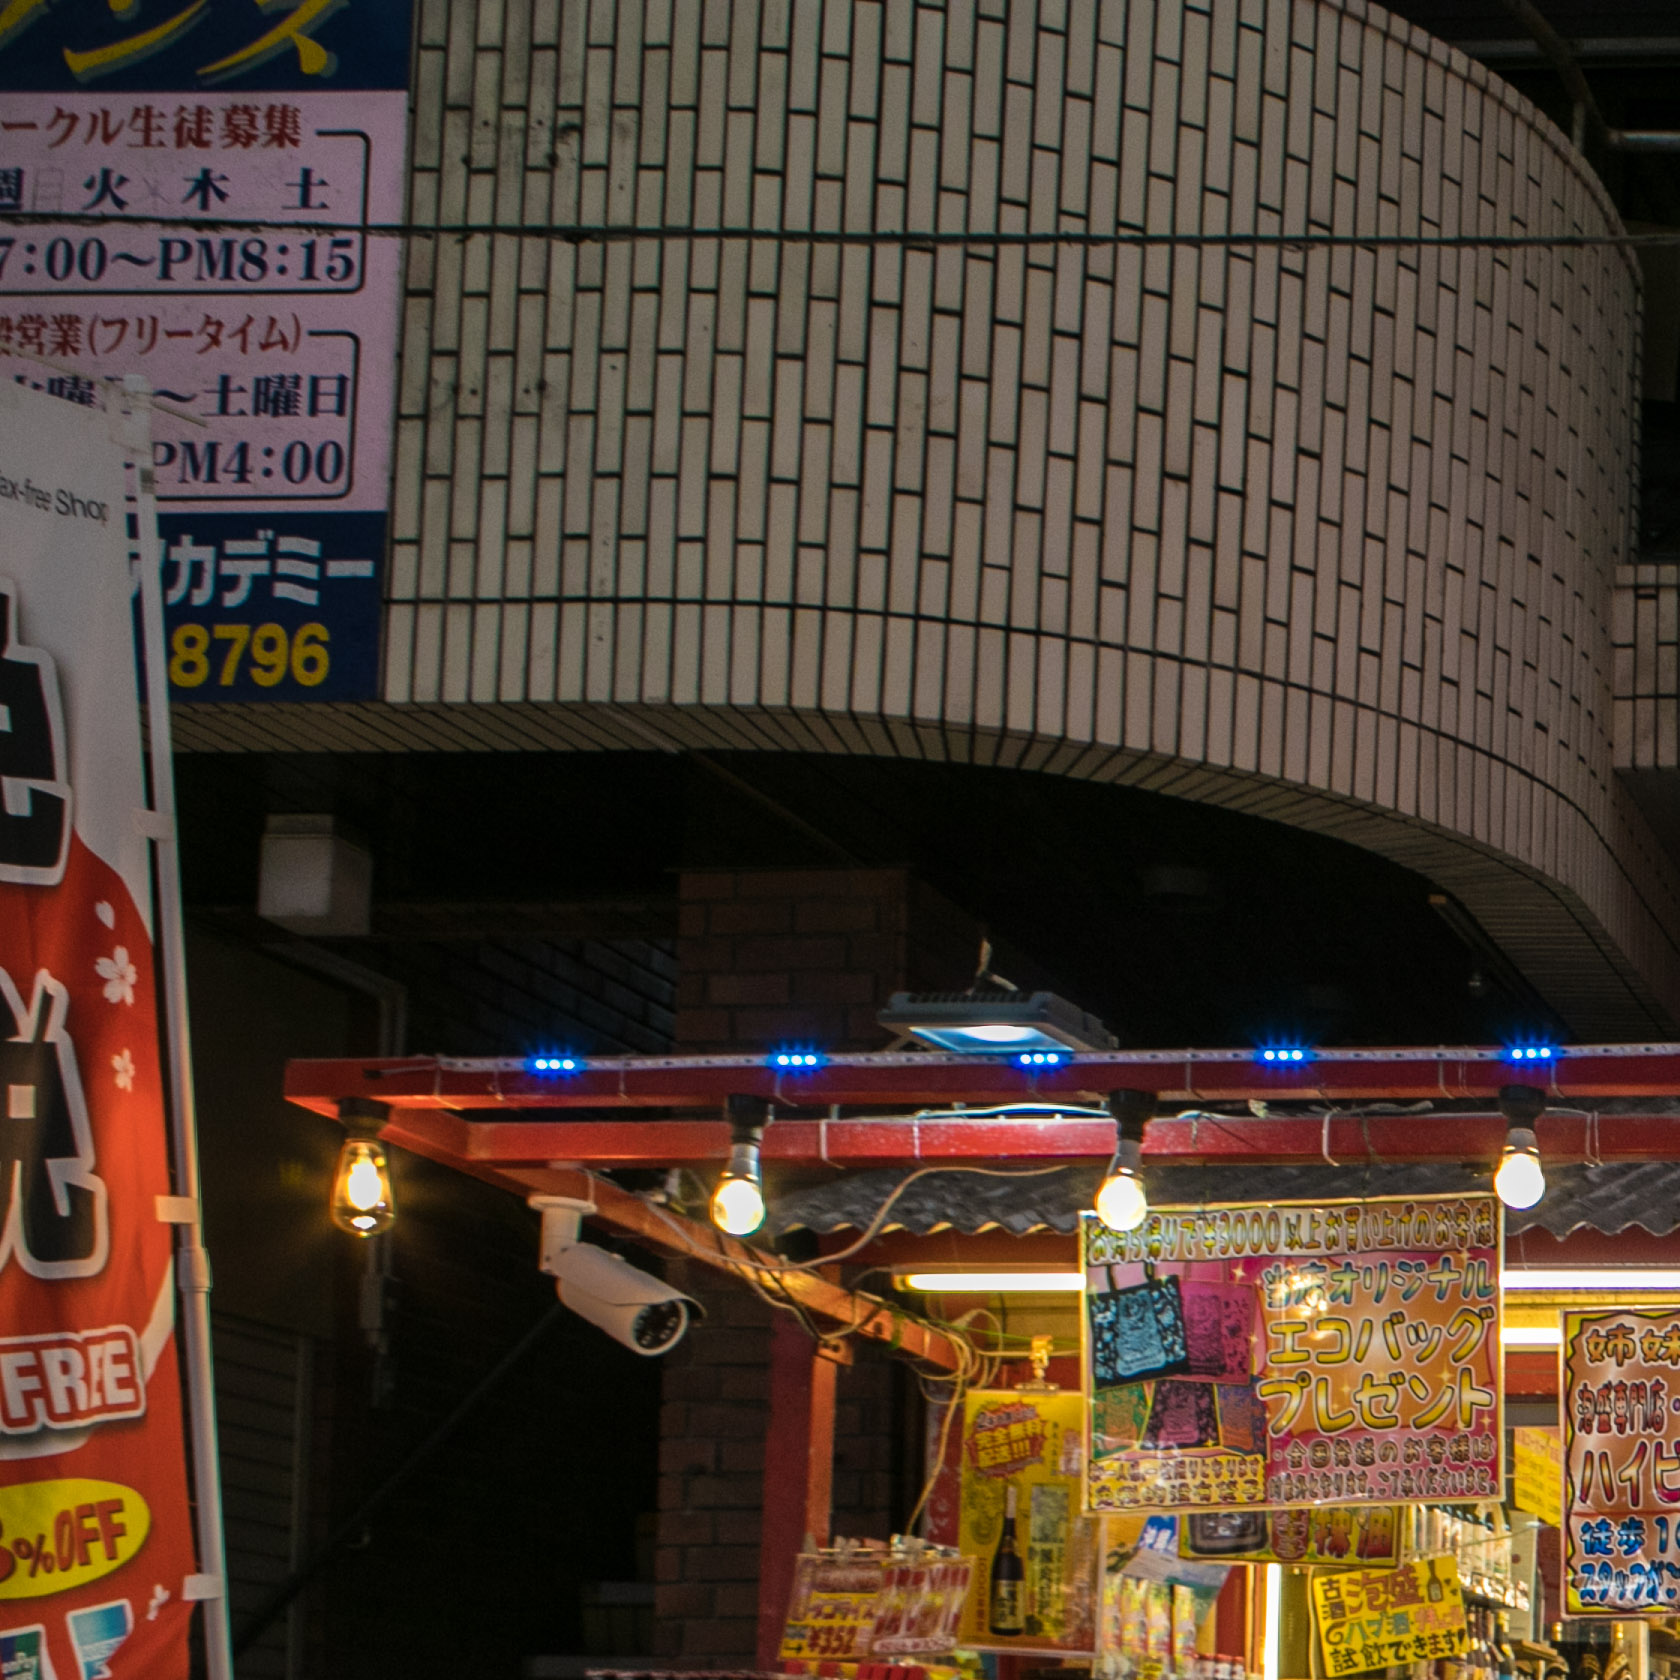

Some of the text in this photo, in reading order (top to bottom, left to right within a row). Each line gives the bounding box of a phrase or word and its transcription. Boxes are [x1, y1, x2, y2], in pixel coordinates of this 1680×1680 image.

[83, 169, 330, 211] 火 木 土
[168, 622, 329, 687] 8796
[1268, 1306, 1496, 1366] エコバッグ
[1259, 1367, 1494, 1435] プレゼント
[1346, 1566, 1425, 1614] 泡盛
